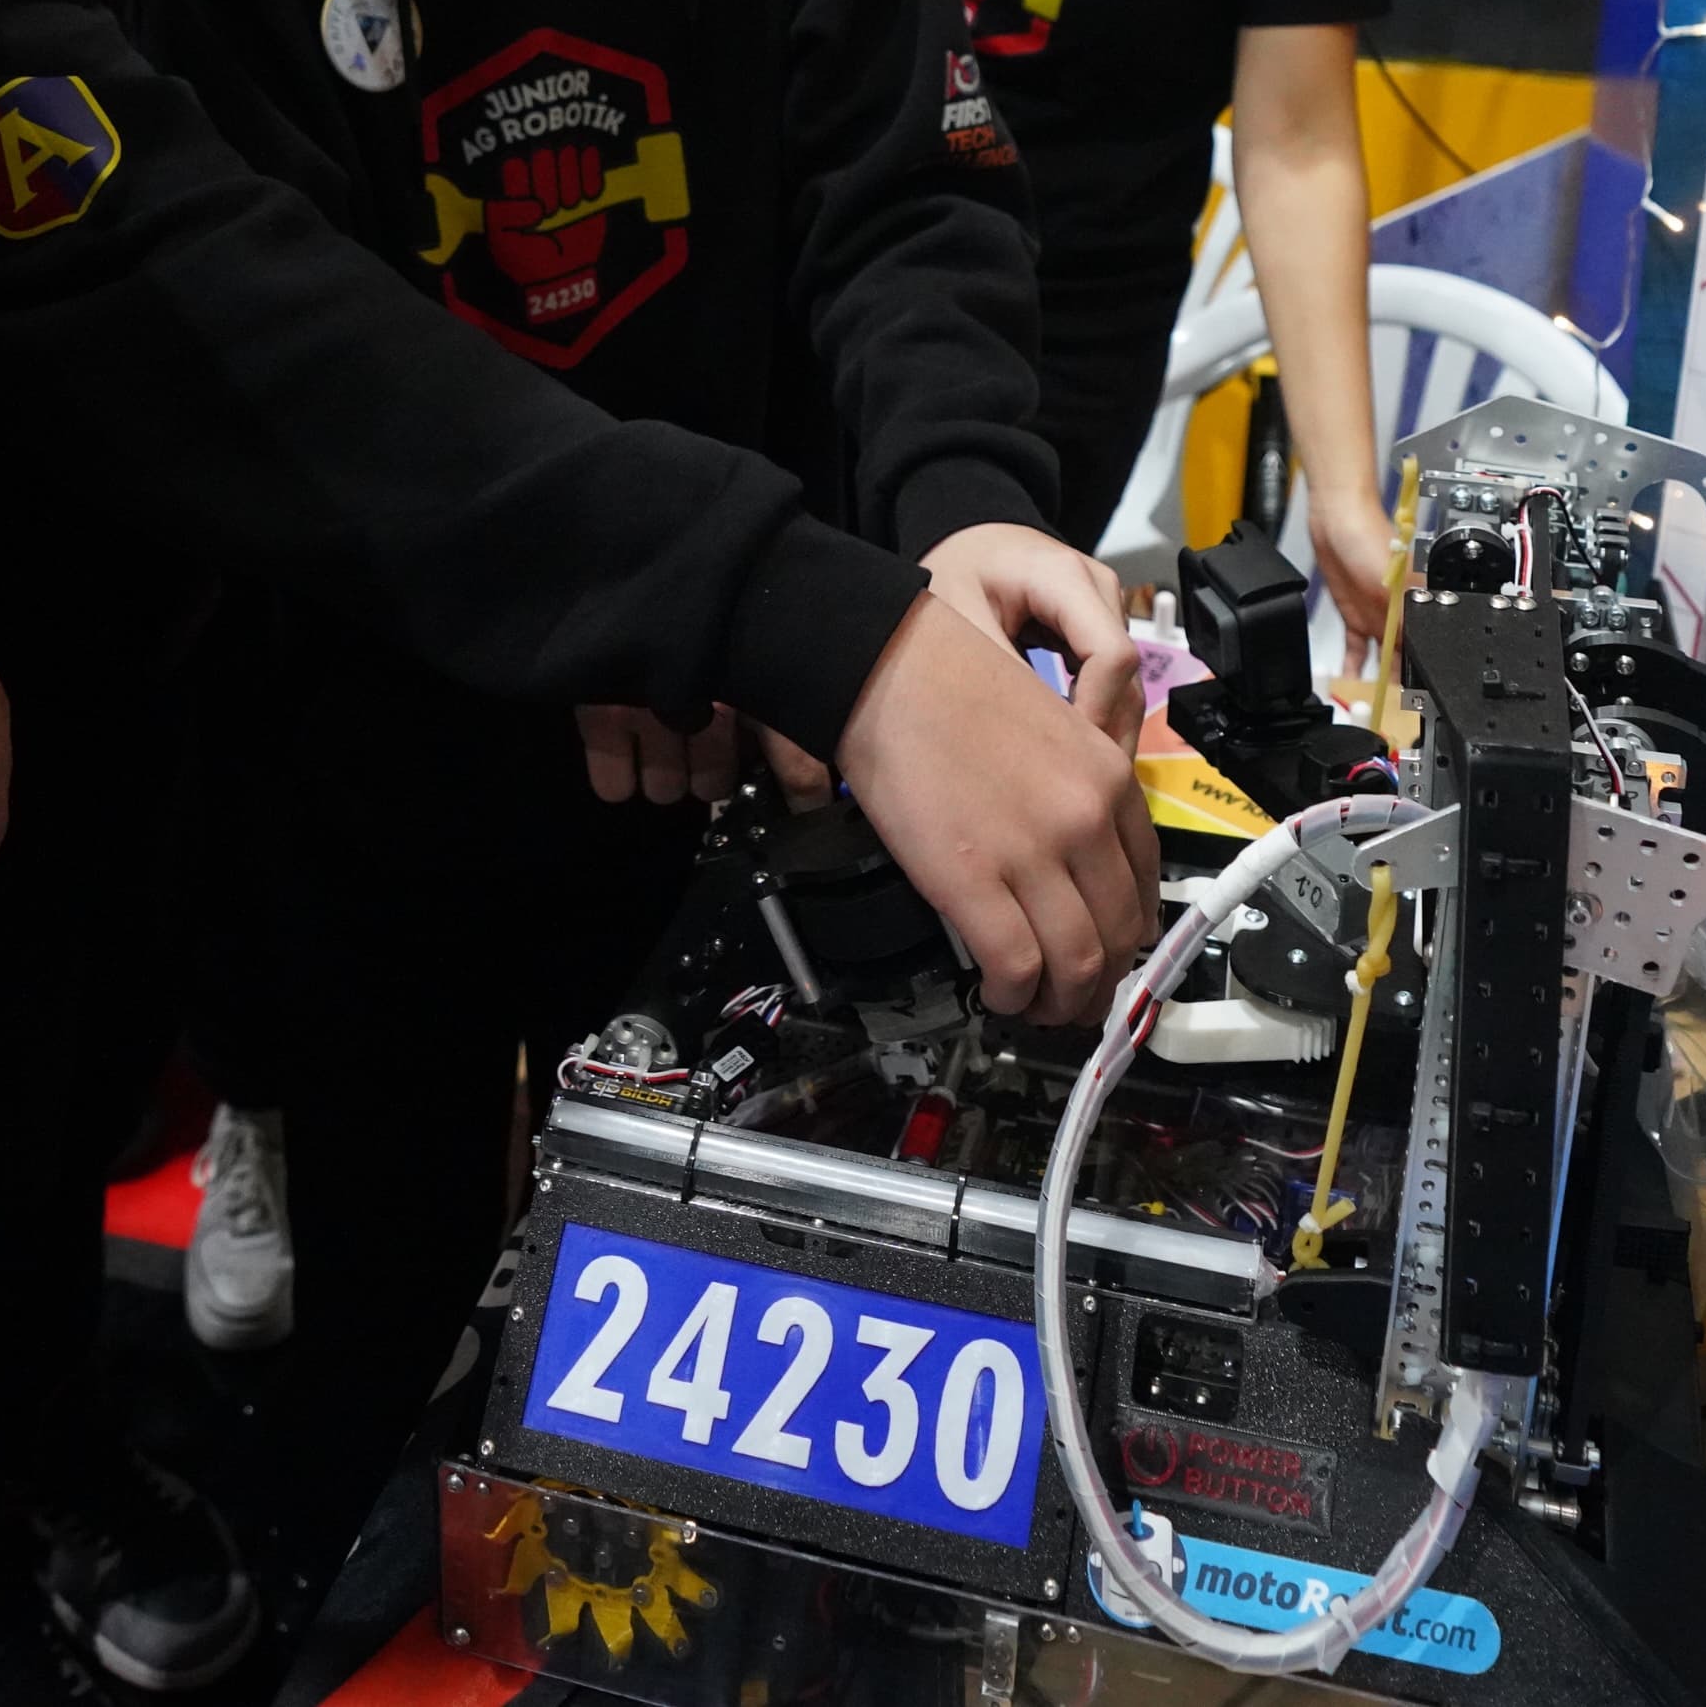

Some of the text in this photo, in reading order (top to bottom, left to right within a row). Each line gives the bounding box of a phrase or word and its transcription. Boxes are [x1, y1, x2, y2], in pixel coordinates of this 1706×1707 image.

[484, 67, 592, 122] JUNIOR
[941, 96, 993, 132] FIRS
[460, 92, 628, 167] AG ROBOTİK
[528, 277, 597, 317] 24230
[545, 1254, 1027, 1511] 24230
[1186, 1431, 1302, 1480] POWER
[1183, 1467, 1312, 1519] BUTTON
[1196, 1561, 1477, 1652] motoRt.com
